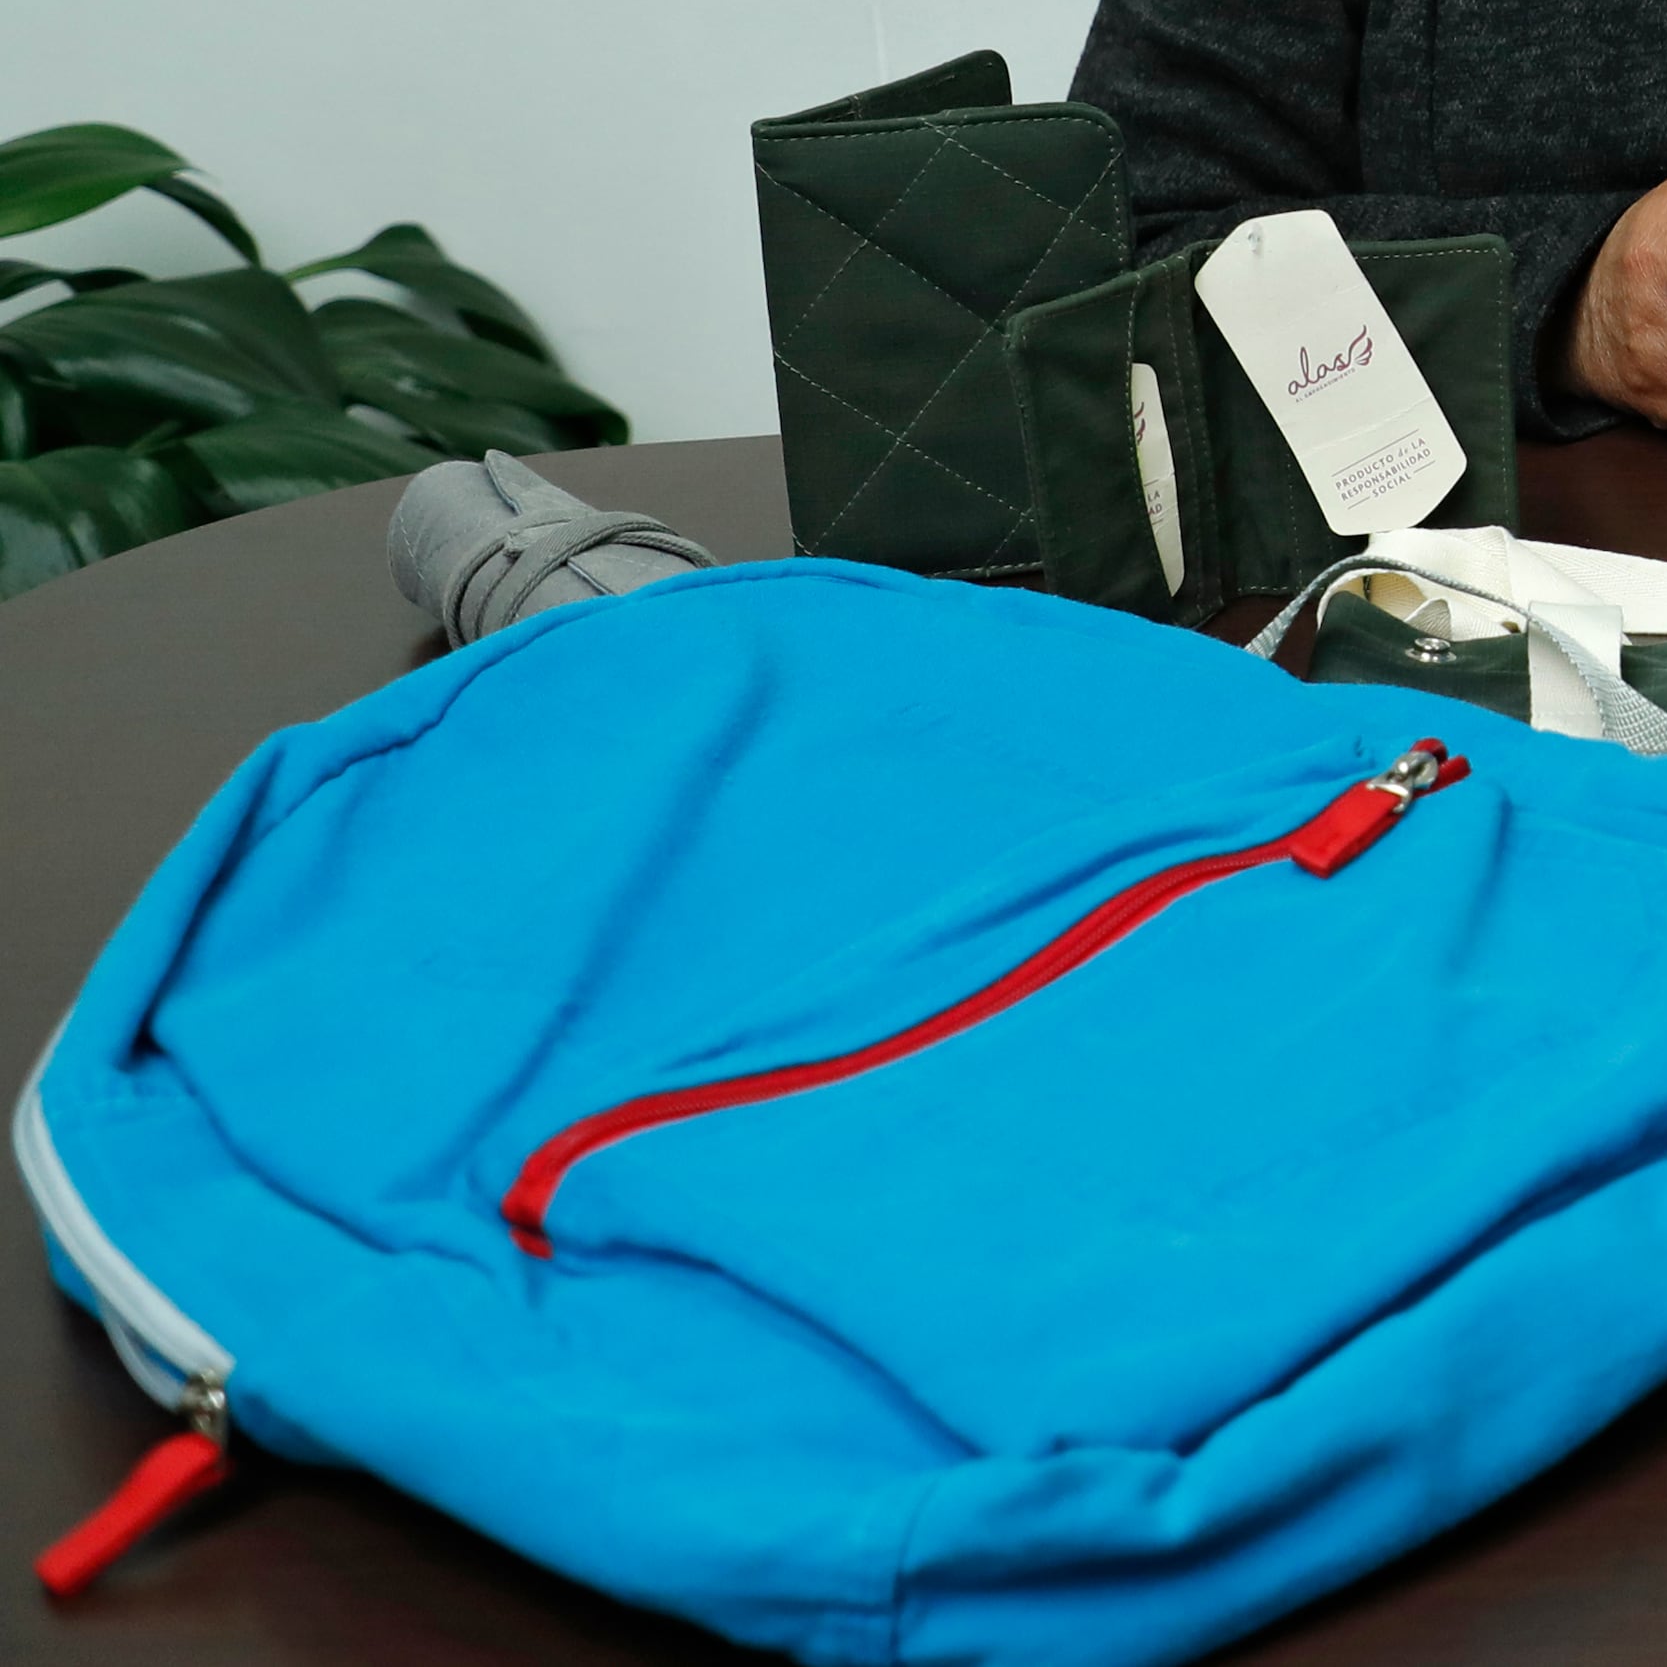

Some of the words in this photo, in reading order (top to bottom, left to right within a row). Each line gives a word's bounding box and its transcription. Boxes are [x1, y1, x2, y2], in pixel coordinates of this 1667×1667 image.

[1288, 324, 1369, 395] alas
[1335, 454, 1394, 490] PRODUCTO
[1398, 447, 1409, 457] de
[1411, 437, 1426, 450] LA
[1341, 448, 1431, 501] RESPONSABILIDAD
[1372, 473, 1412, 498] SOCIAL
[1148, 490, 1160, 502] LA
